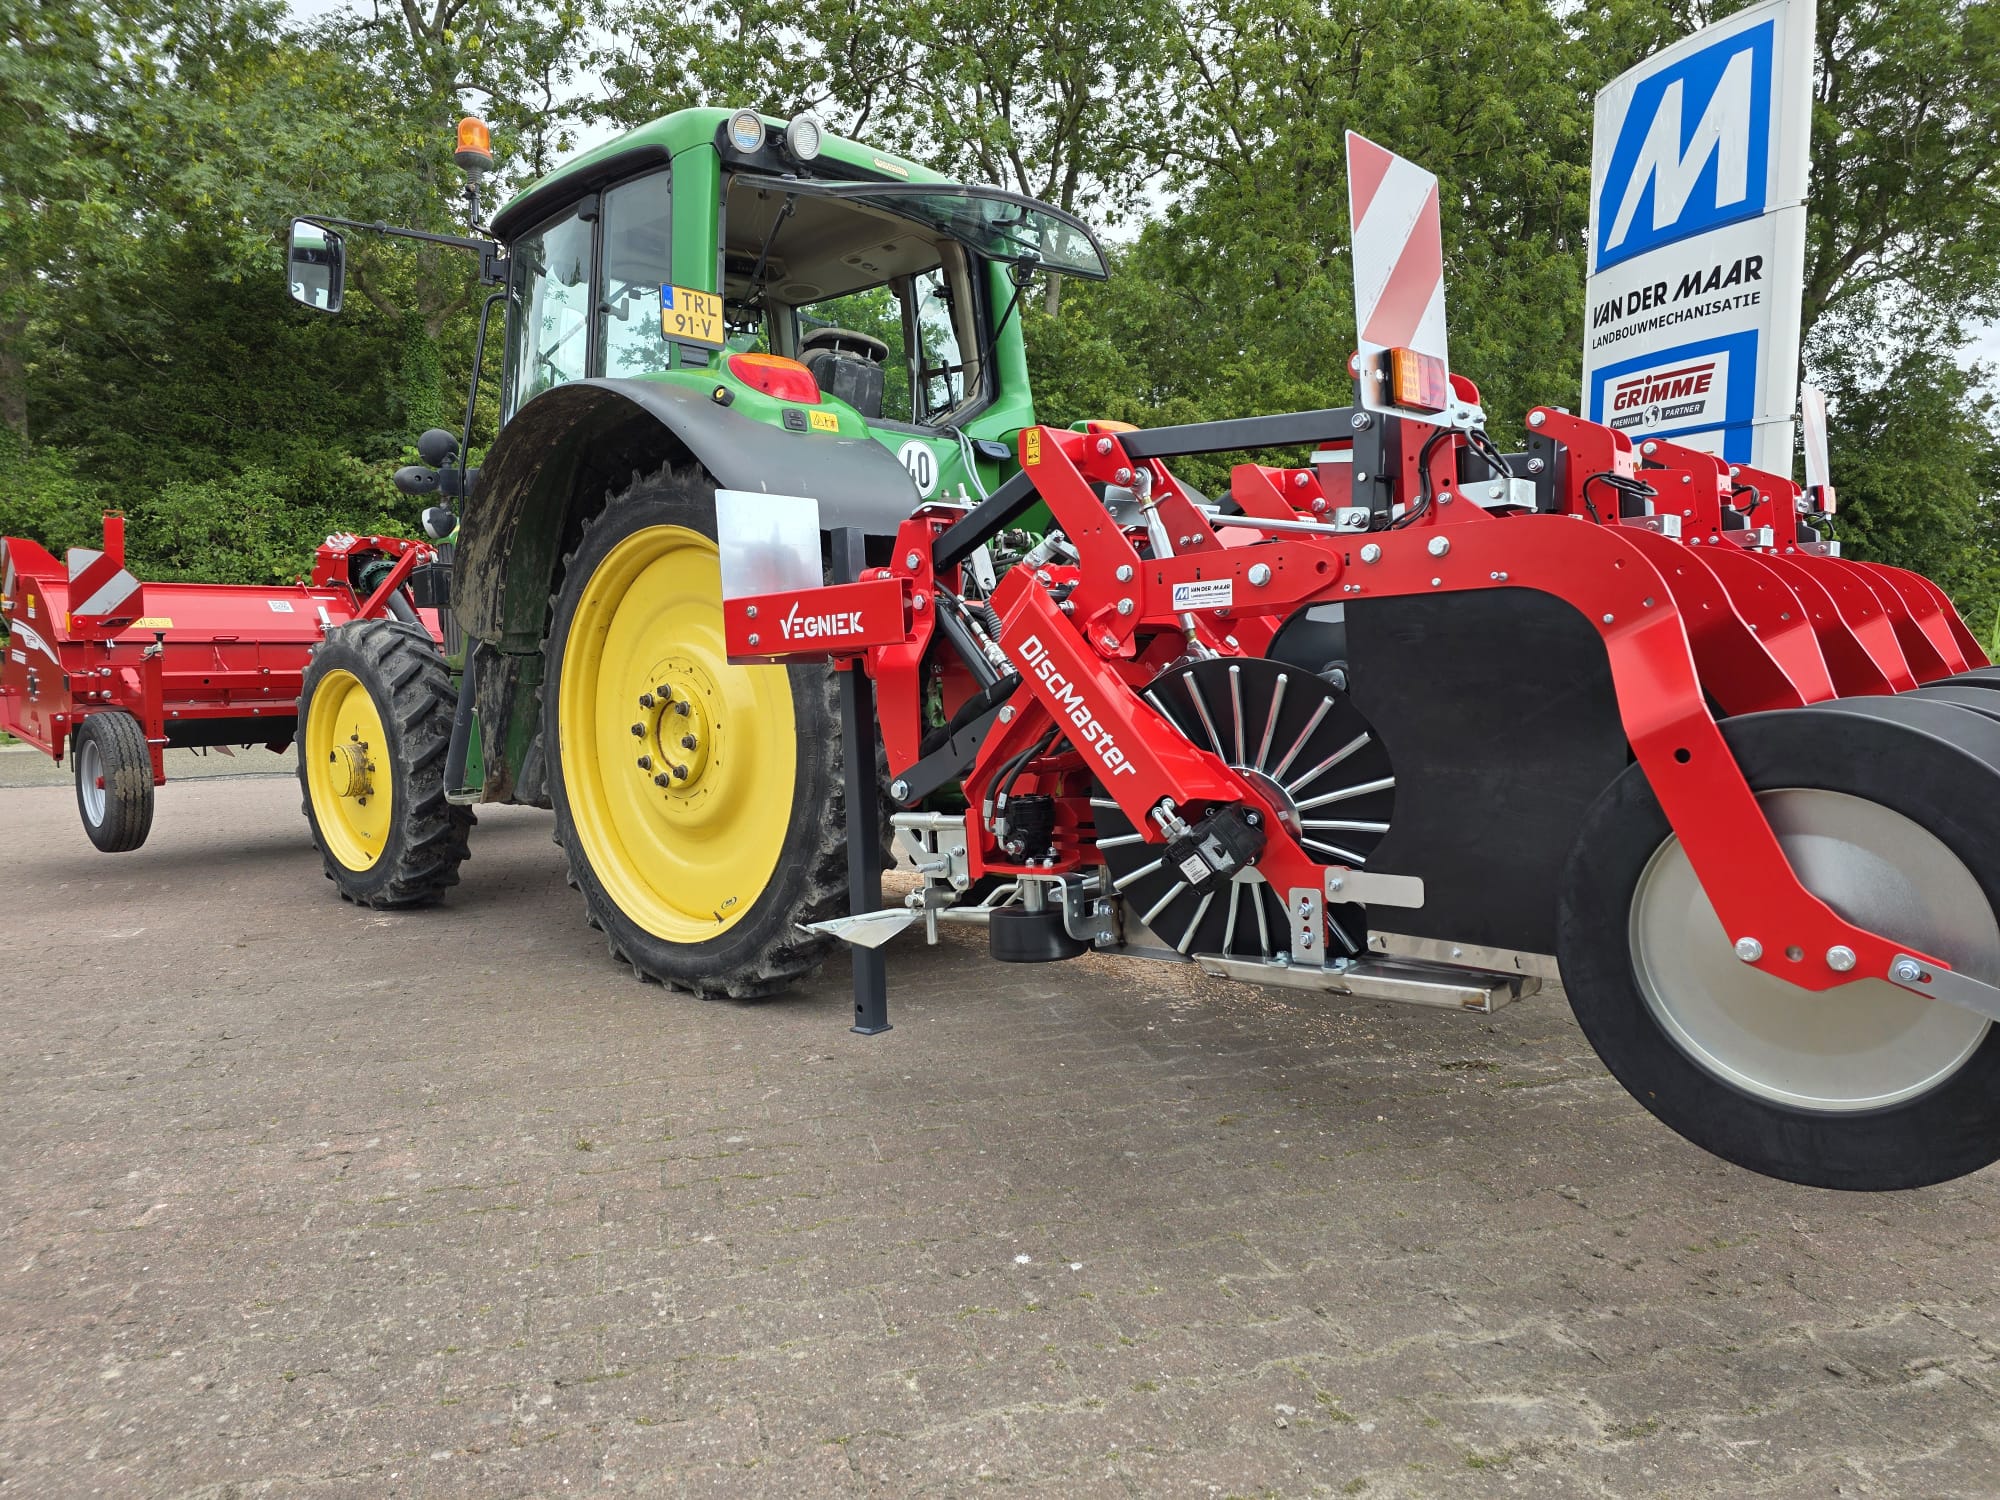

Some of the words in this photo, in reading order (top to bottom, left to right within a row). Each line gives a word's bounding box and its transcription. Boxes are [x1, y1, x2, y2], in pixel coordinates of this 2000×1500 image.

[1605, 47, 1753, 252] M
[682, 292, 717, 317] TRL
[1592, 296, 1623, 329] VAN
[1627, 281, 1667, 316] DER
[1672, 255, 1763, 302] MAAR
[675, 313, 711, 338] 91-V
[1592, 291, 1761, 350] LANDBOUWMECHANISATIE
[1613, 370, 1714, 411] GRIMME
[1612, 415, 1640, 428] PREMIUM
[1665, 404, 1701, 417] PARTNER
[779, 600, 864, 640] VEGNIEK
[1018, 634, 1137, 776] DiscMaster
